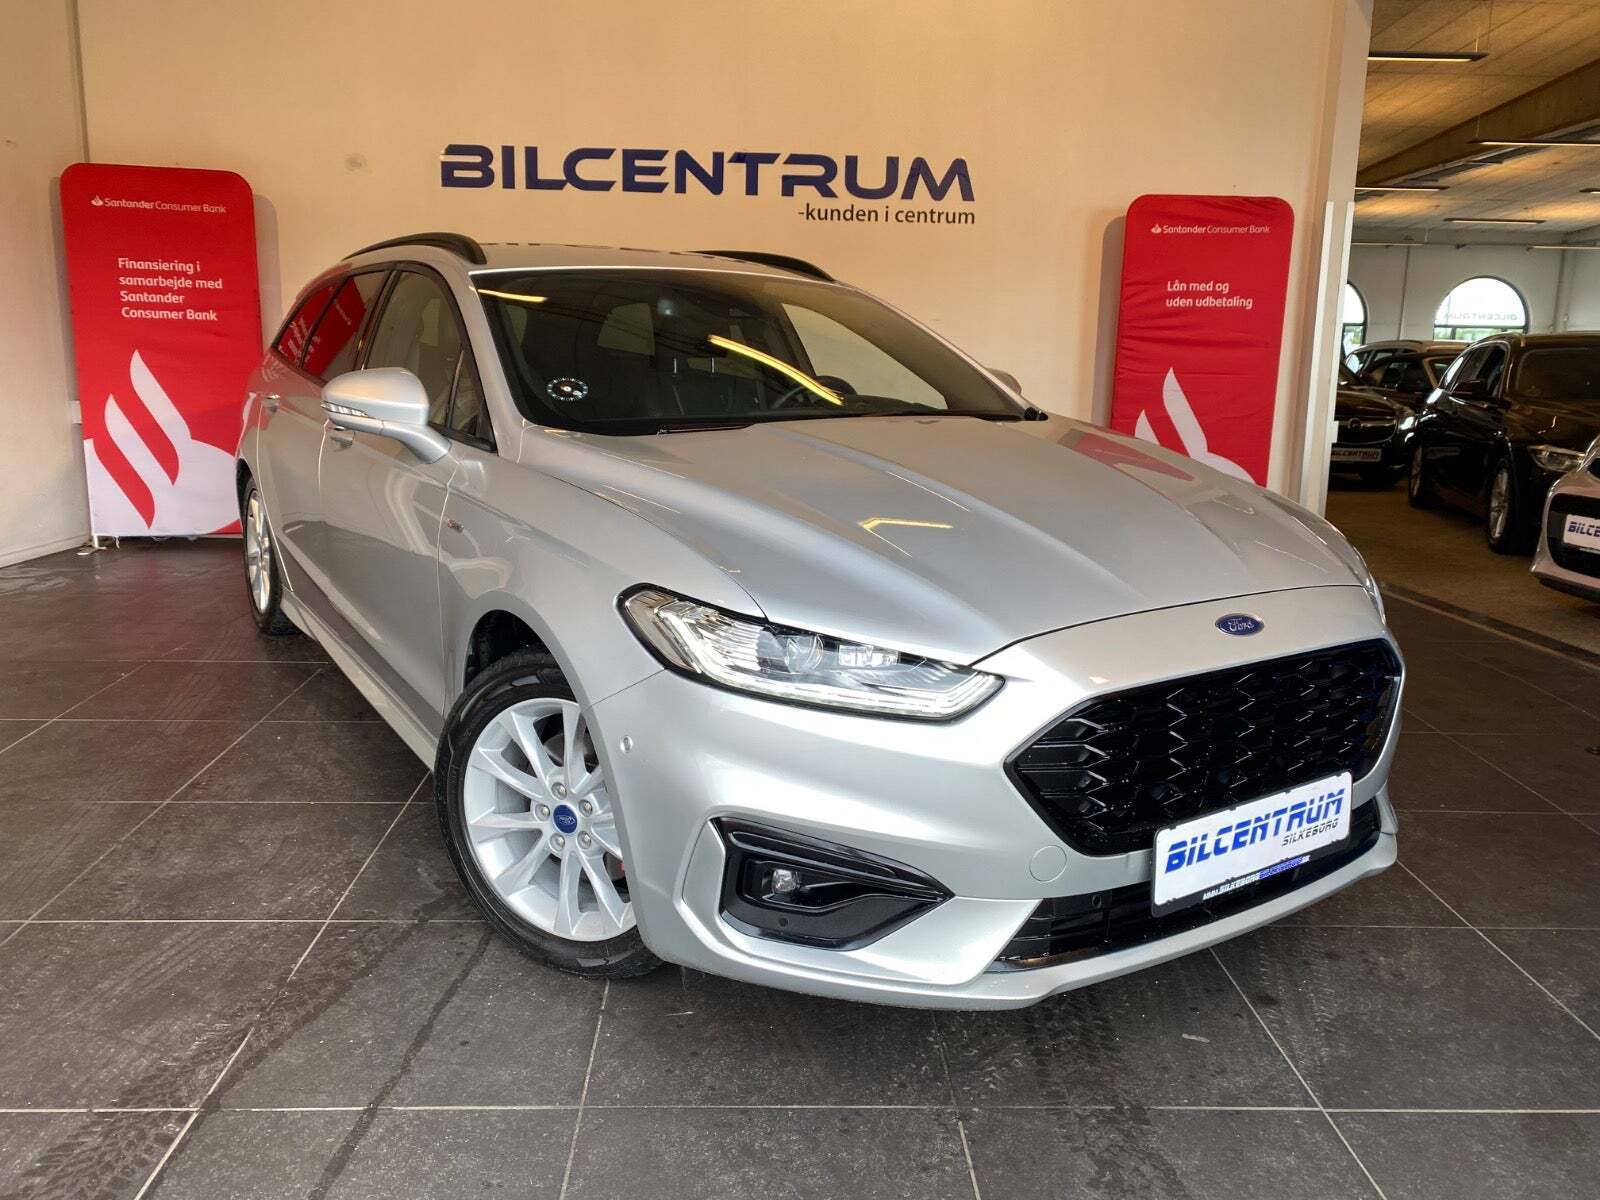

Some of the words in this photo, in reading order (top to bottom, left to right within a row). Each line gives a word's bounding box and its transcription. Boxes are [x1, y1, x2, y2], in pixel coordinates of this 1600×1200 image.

[440, 144, 975, 202] BILCENTRUM
[104, 197, 154, 209] Santander
[155, 201, 202, 212] Consumer
[203, 203, 226, 213] Bank
[798, 203, 878, 222] -kunden
[885, 205, 889, 222] i
[895, 207, 975, 224] centrum
[1163, 225, 1206, 234] Santander
[1207, 225, 1248, 234] Consumer
[1249, 225, 1270, 234] Bank
[118, 257, 194, 275] Finansiering
[196, 261, 201, 273] i
[119, 275, 192, 290] samarbejde
[196, 278, 223, 290] med
[1167, 280, 1187, 292] Lån
[1189, 281, 1213, 292] med
[1215, 283, 1230, 294] og
[120, 291, 185, 304] Santander
[1166, 296, 1193, 308] uden
[1195, 296, 1253, 309] udbetaling
[121, 307, 183, 320] Consumer
[186, 309, 218, 321] Bank
[1165, 788, 1346, 874] BILCENTRUM
[1281, 818, 1340, 848] SILKEBORG
